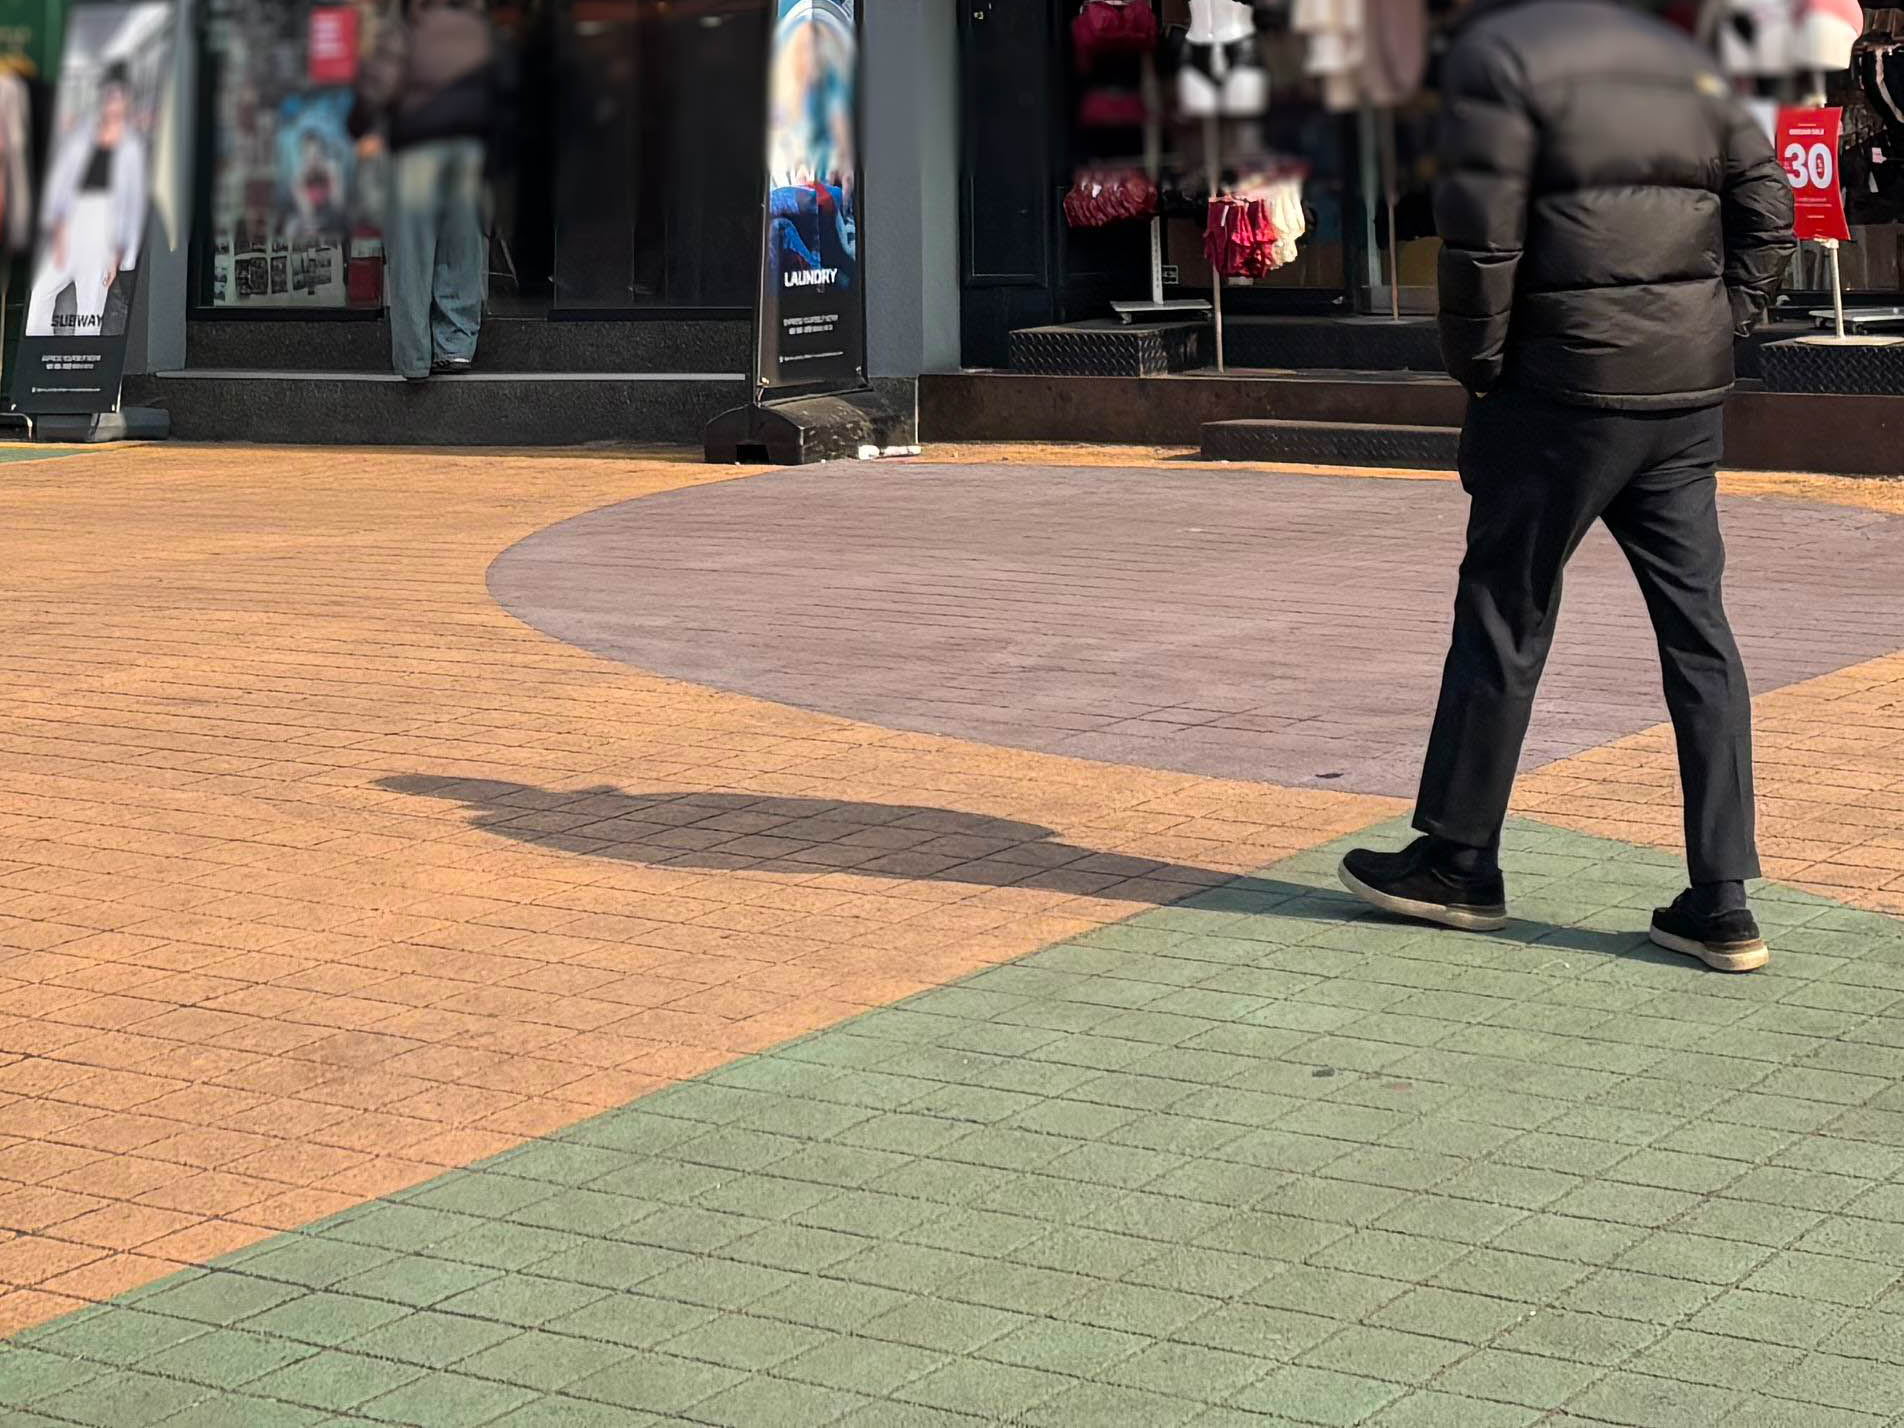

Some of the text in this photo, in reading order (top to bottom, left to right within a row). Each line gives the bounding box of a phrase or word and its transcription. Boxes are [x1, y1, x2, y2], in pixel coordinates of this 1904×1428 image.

[1784, 142, 1833, 189] 30
[783, 267, 838, 288] LAUNDRY
[51, 314, 103, 328] SUBWAY
